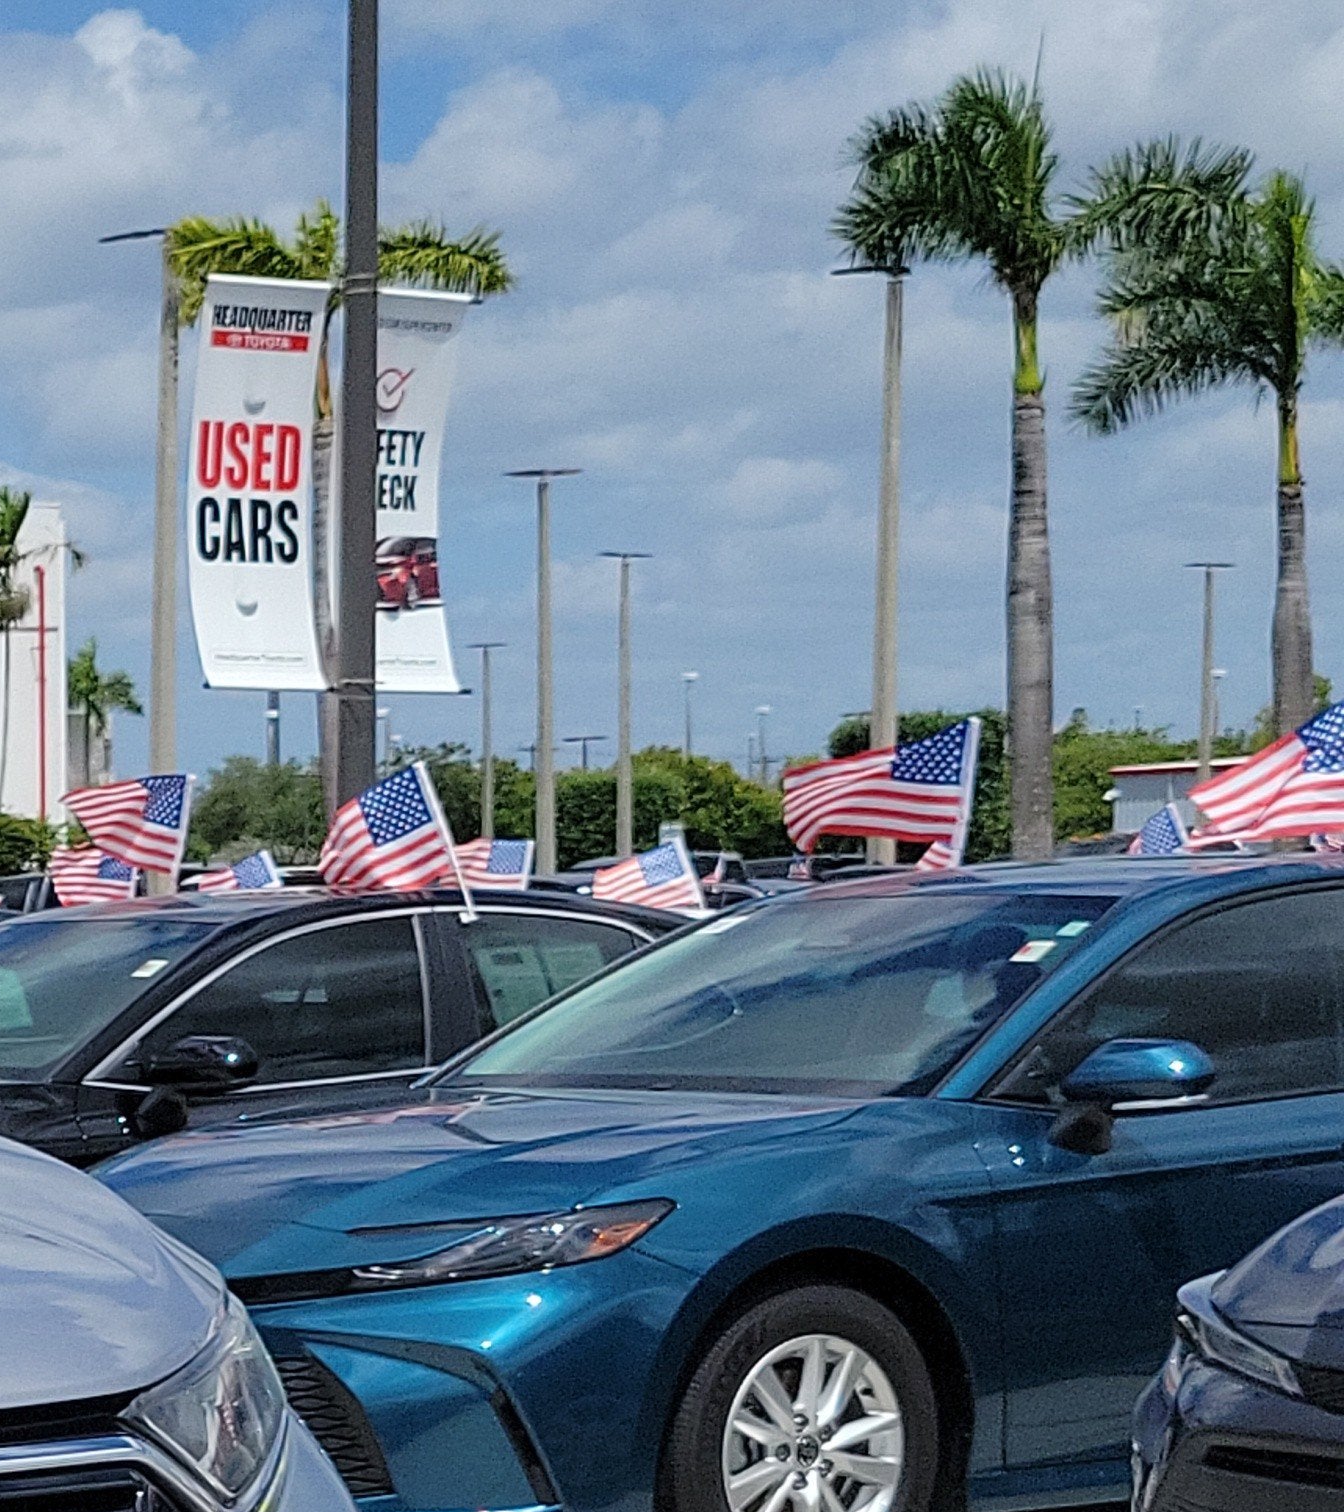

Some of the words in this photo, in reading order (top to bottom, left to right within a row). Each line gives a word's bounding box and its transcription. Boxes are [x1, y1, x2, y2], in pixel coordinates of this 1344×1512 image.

[213, 304, 312, 334] HEADQUARTER
[197, 420, 301, 492] USED
[376, 428, 425, 468] FETY
[377, 473, 417, 511] ECK
[196, 496, 300, 564] CARS
